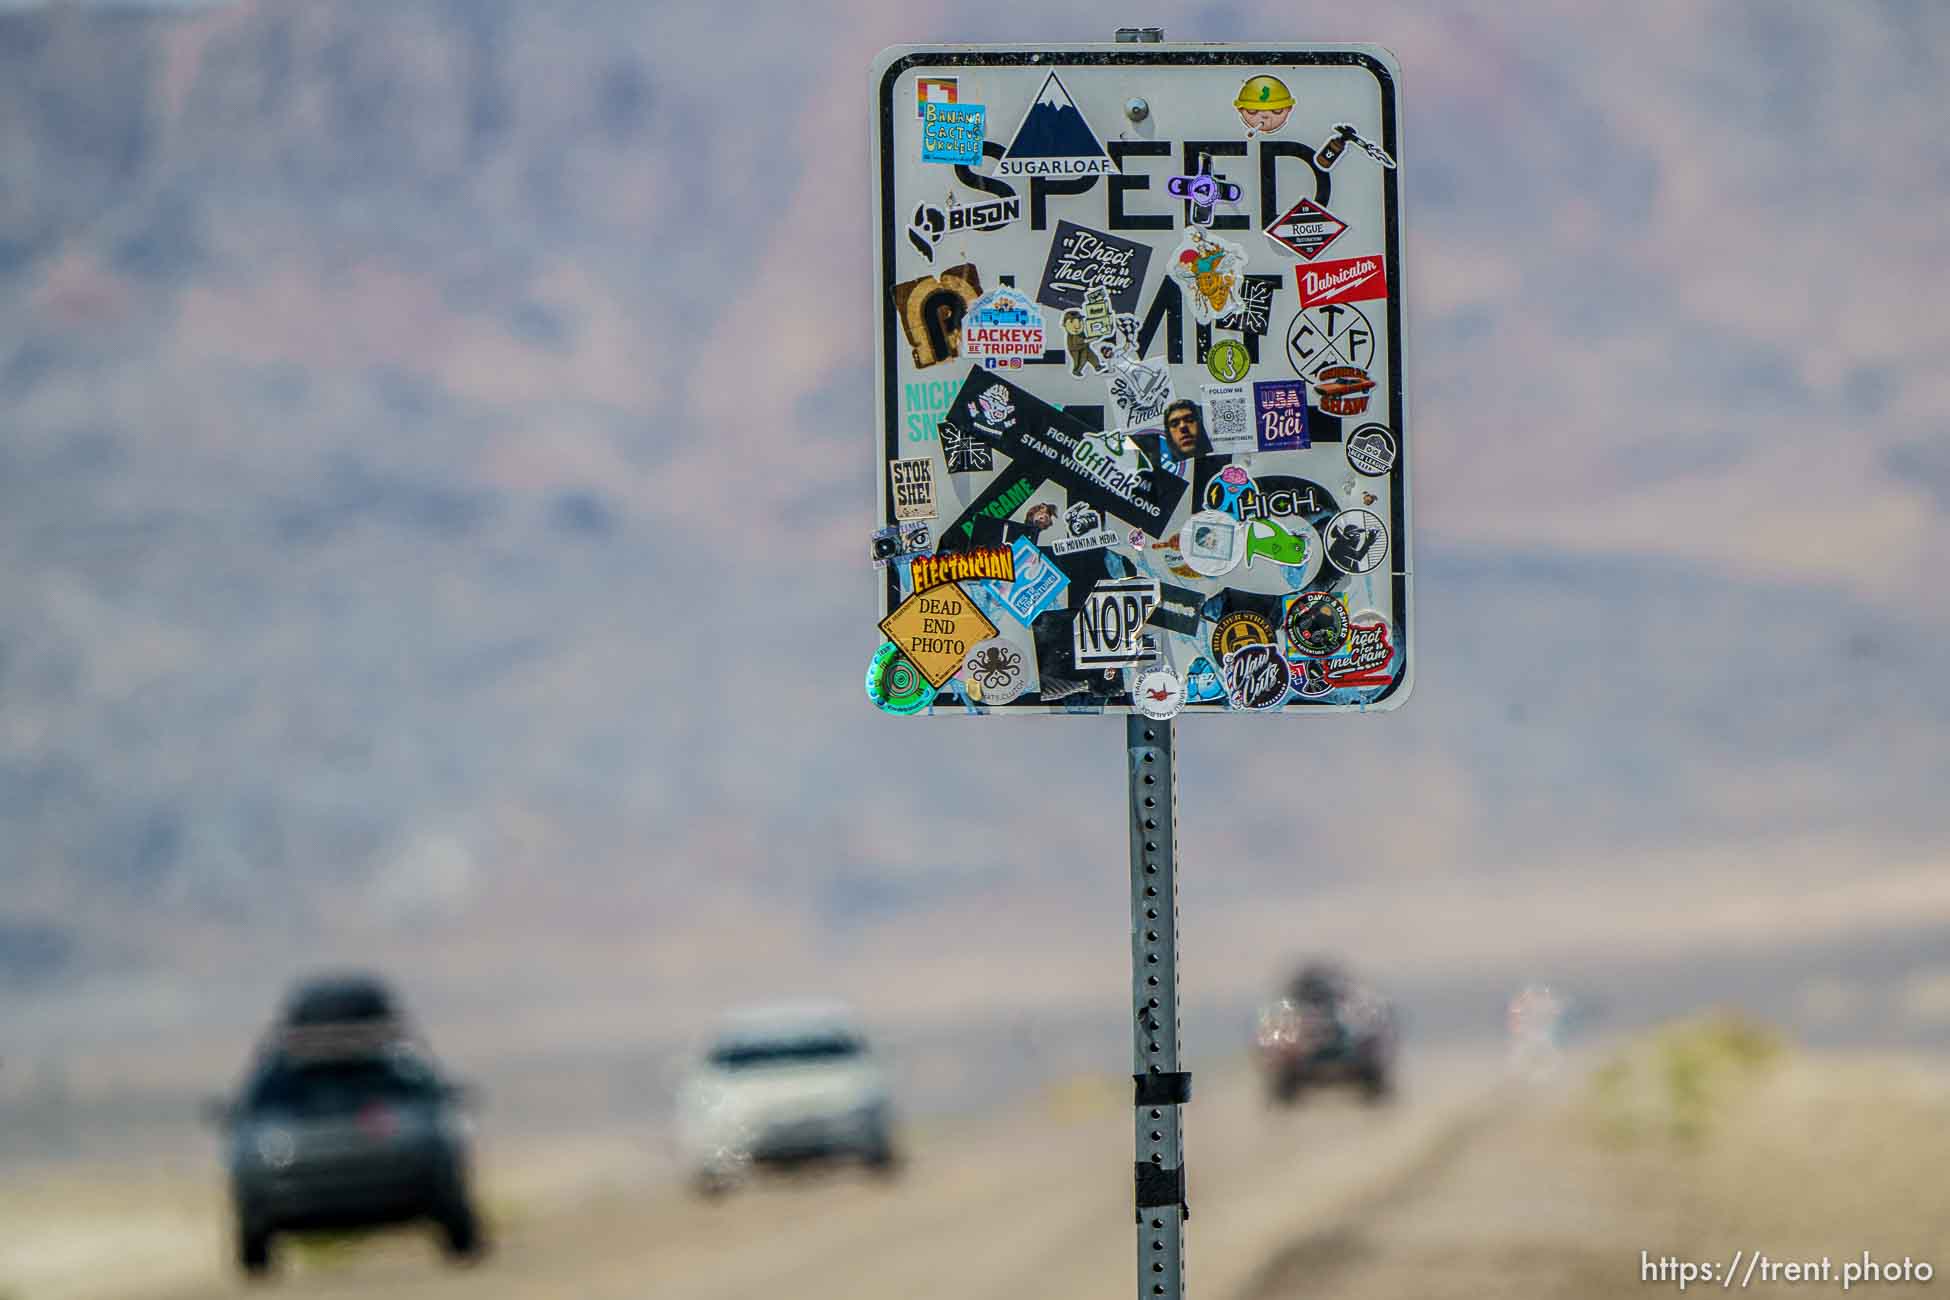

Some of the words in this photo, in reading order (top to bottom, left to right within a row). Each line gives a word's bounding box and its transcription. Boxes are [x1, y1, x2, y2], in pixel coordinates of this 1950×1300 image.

[926, 104, 982, 124] BANANA
[925, 122, 980, 141] CACTUS
[925, 138, 979, 154] UKULELE
[1000, 160, 1111, 174] SUGARLOAF
[954, 140, 1332, 231] SPEED
[949, 200, 1020, 230] BISON
[967, 328, 1043, 342] LACKEYS
[1262, 391, 1300, 409] USA
[1262, 411, 1302, 440] Bici
[1021, 433, 1059, 459] STAND
[1046, 427, 1080, 449] FIGHT
[893, 460, 932, 483] STOK
[897, 483, 932, 506] SHE!
[1055, 543, 1065, 554] BIG
[1067, 536, 1098, 551] MOUNTAIN
[1099, 533, 1118, 545] MEDIA
[912, 546, 1013, 592] ELECTRICIAN
[920, 599, 962, 615] DEAD
[923, 619, 955, 634] END
[1080, 595, 1156, 652] NOPE
[911, 637, 965, 655] PHOTO
